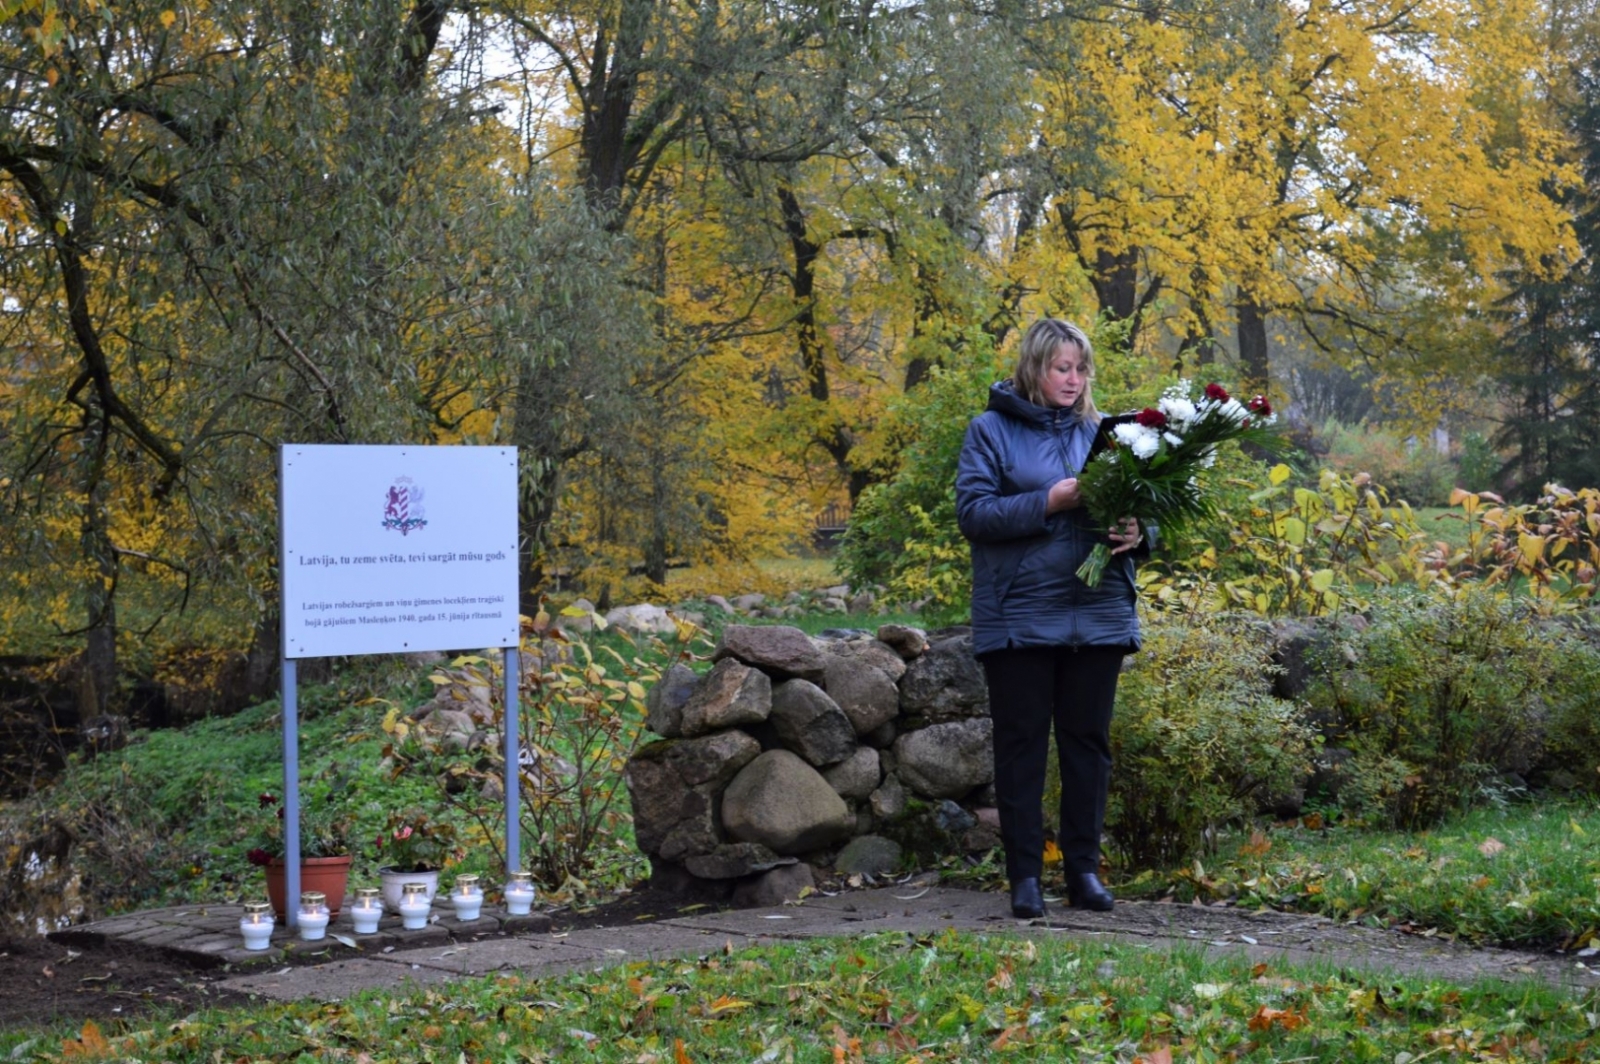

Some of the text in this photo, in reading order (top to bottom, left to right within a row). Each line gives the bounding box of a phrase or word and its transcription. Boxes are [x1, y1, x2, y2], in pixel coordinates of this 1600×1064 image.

[299, 550, 506, 568] Latvija, tu zeme svēta, tevi sargāt mūsu gods
[302, 602, 333, 612] Latvijas
[304, 618, 321, 628] bojā
[323, 617, 357, 627] gājušiem
[398, 614, 417, 622] 1940.
[418, 613, 435, 623] gada
